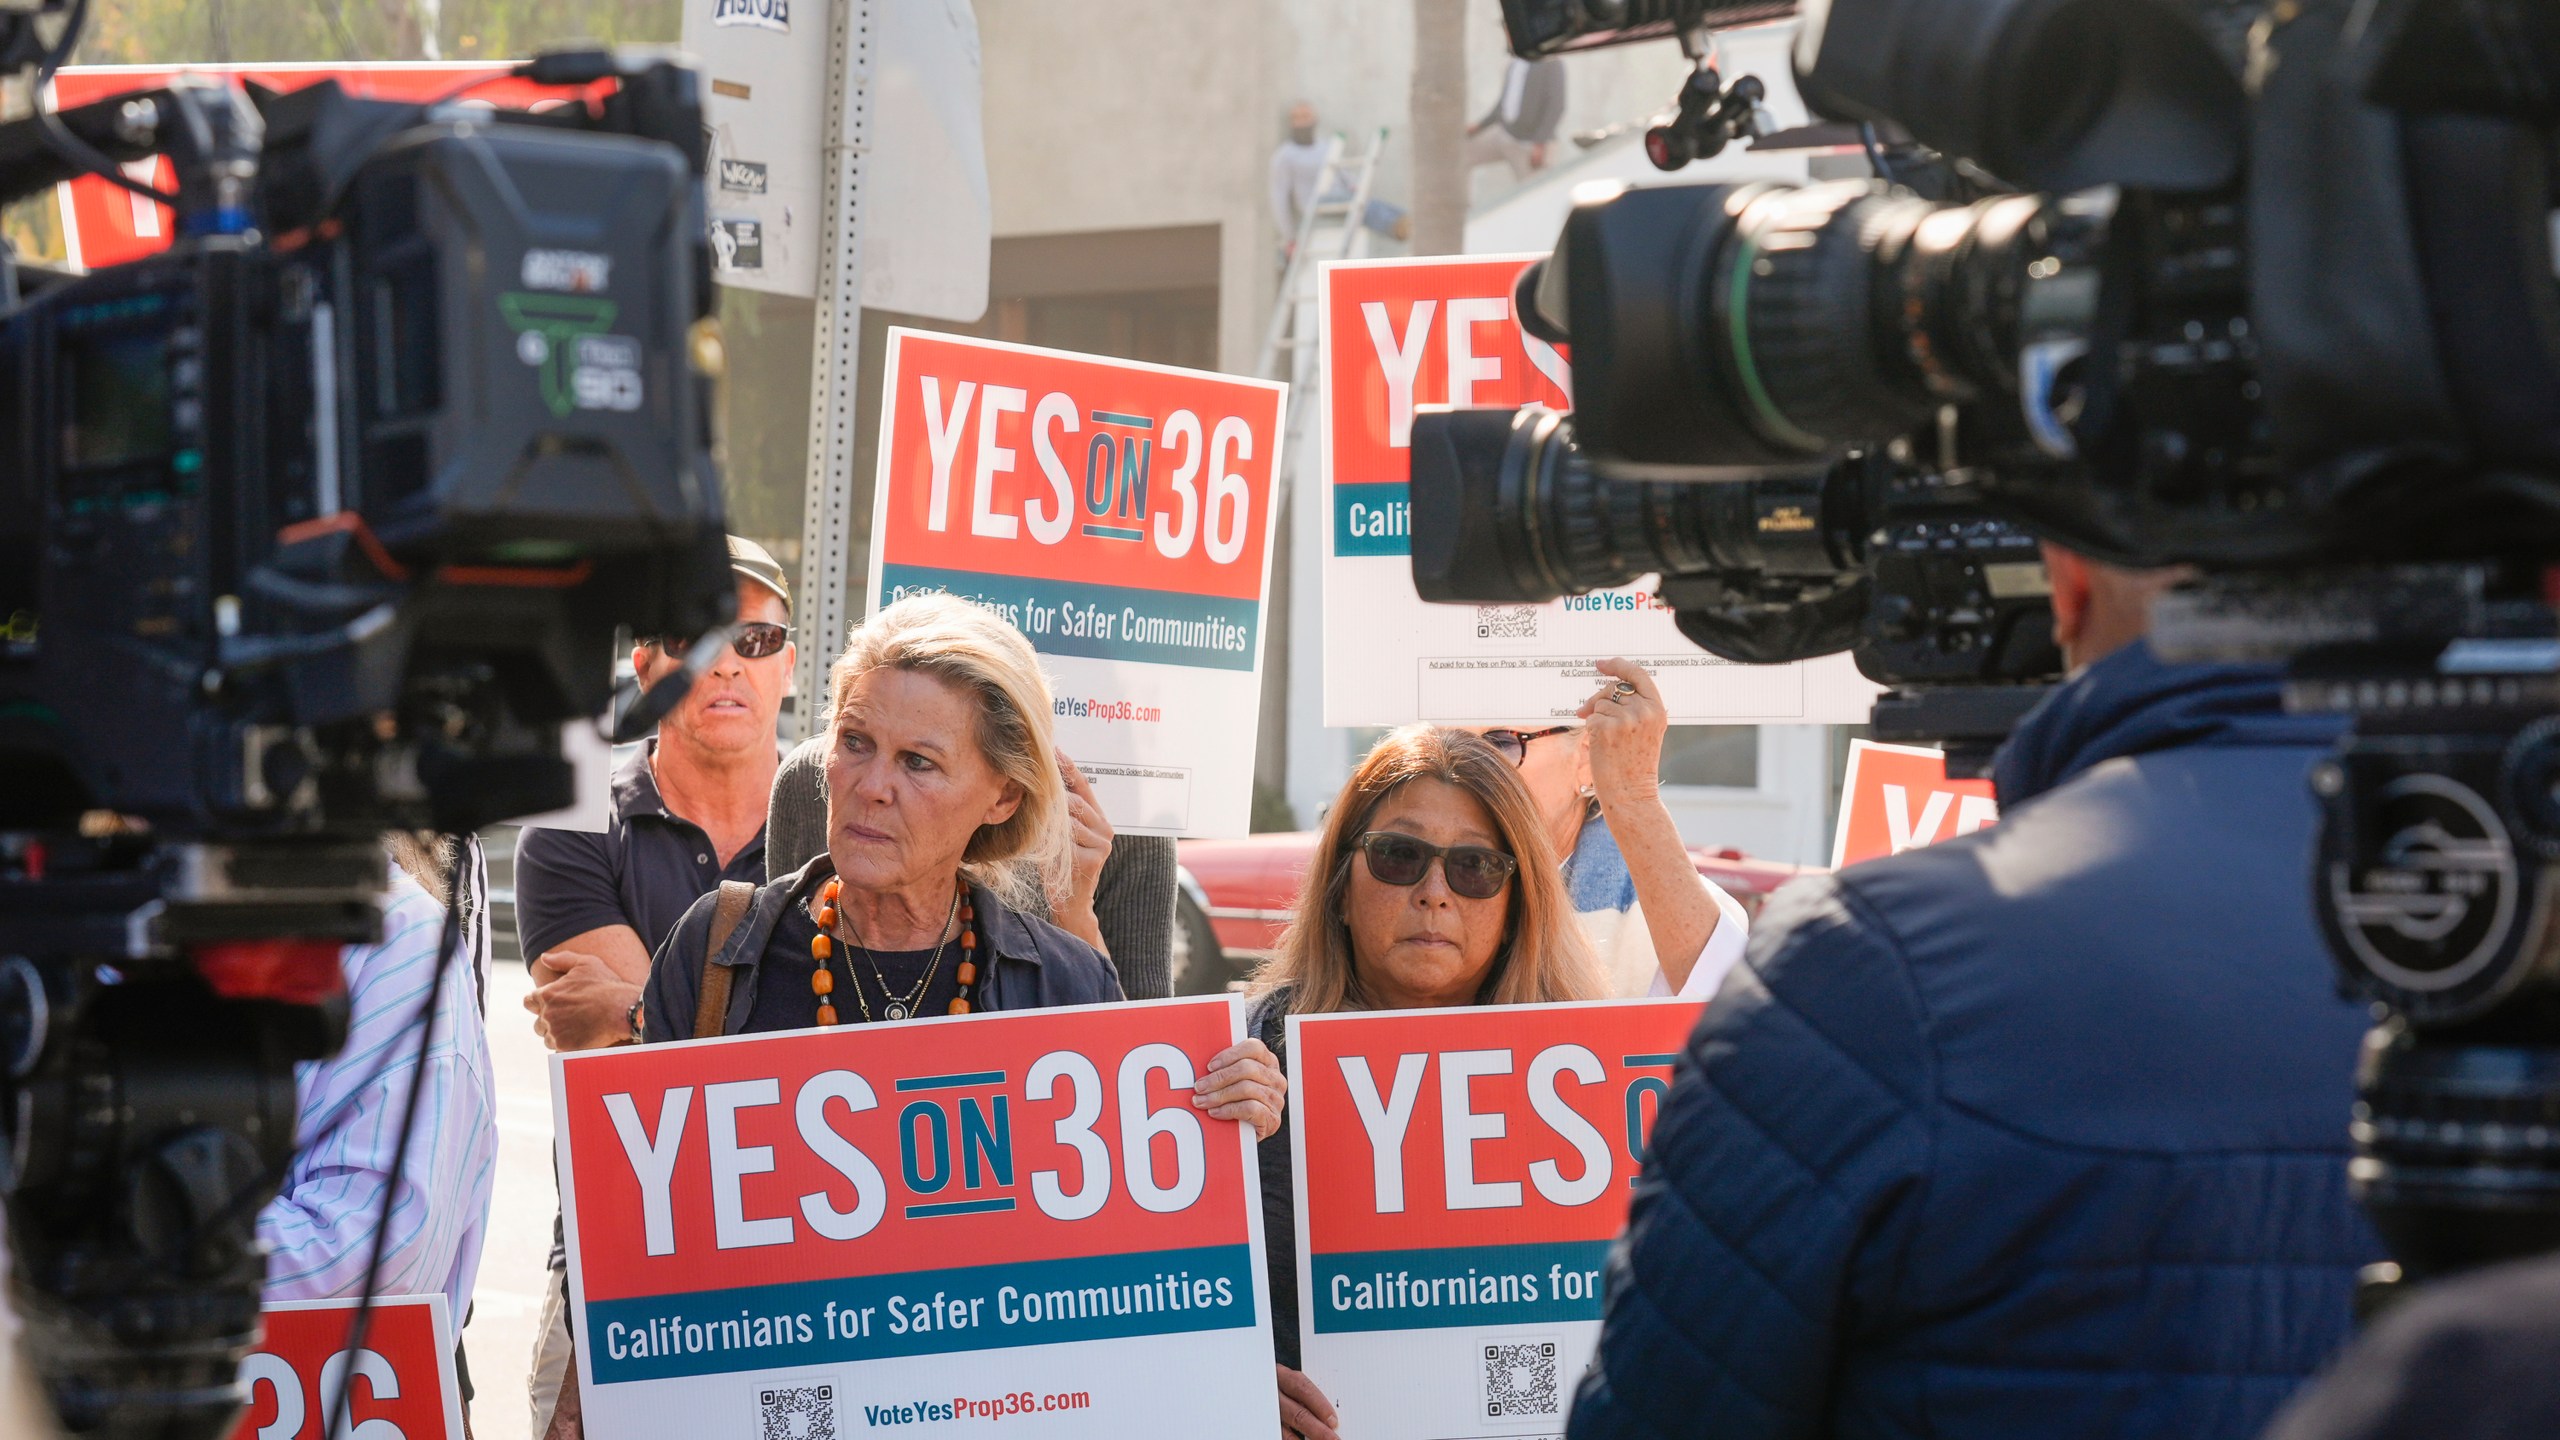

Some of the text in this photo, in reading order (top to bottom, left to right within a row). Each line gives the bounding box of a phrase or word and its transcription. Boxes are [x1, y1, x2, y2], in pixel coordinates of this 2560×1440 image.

[920, 375, 1253, 564] YES ON 36
[1025, 597, 1055, 634] for
[1061, 600, 1117, 640] Safer
[1121, 606, 1247, 652] Communities
[1053, 697, 1161, 723] teYesProp36.com
[602, 1042, 1206, 1257] YES ON 36
[1336, 1043, 1613, 1214] YES
[607, 1271, 1234, 1361] Californians for Safer Communities
[1331, 1264, 1598, 1311] Californians for
[864, 1389, 1091, 1428] VoteYesProp36.com
